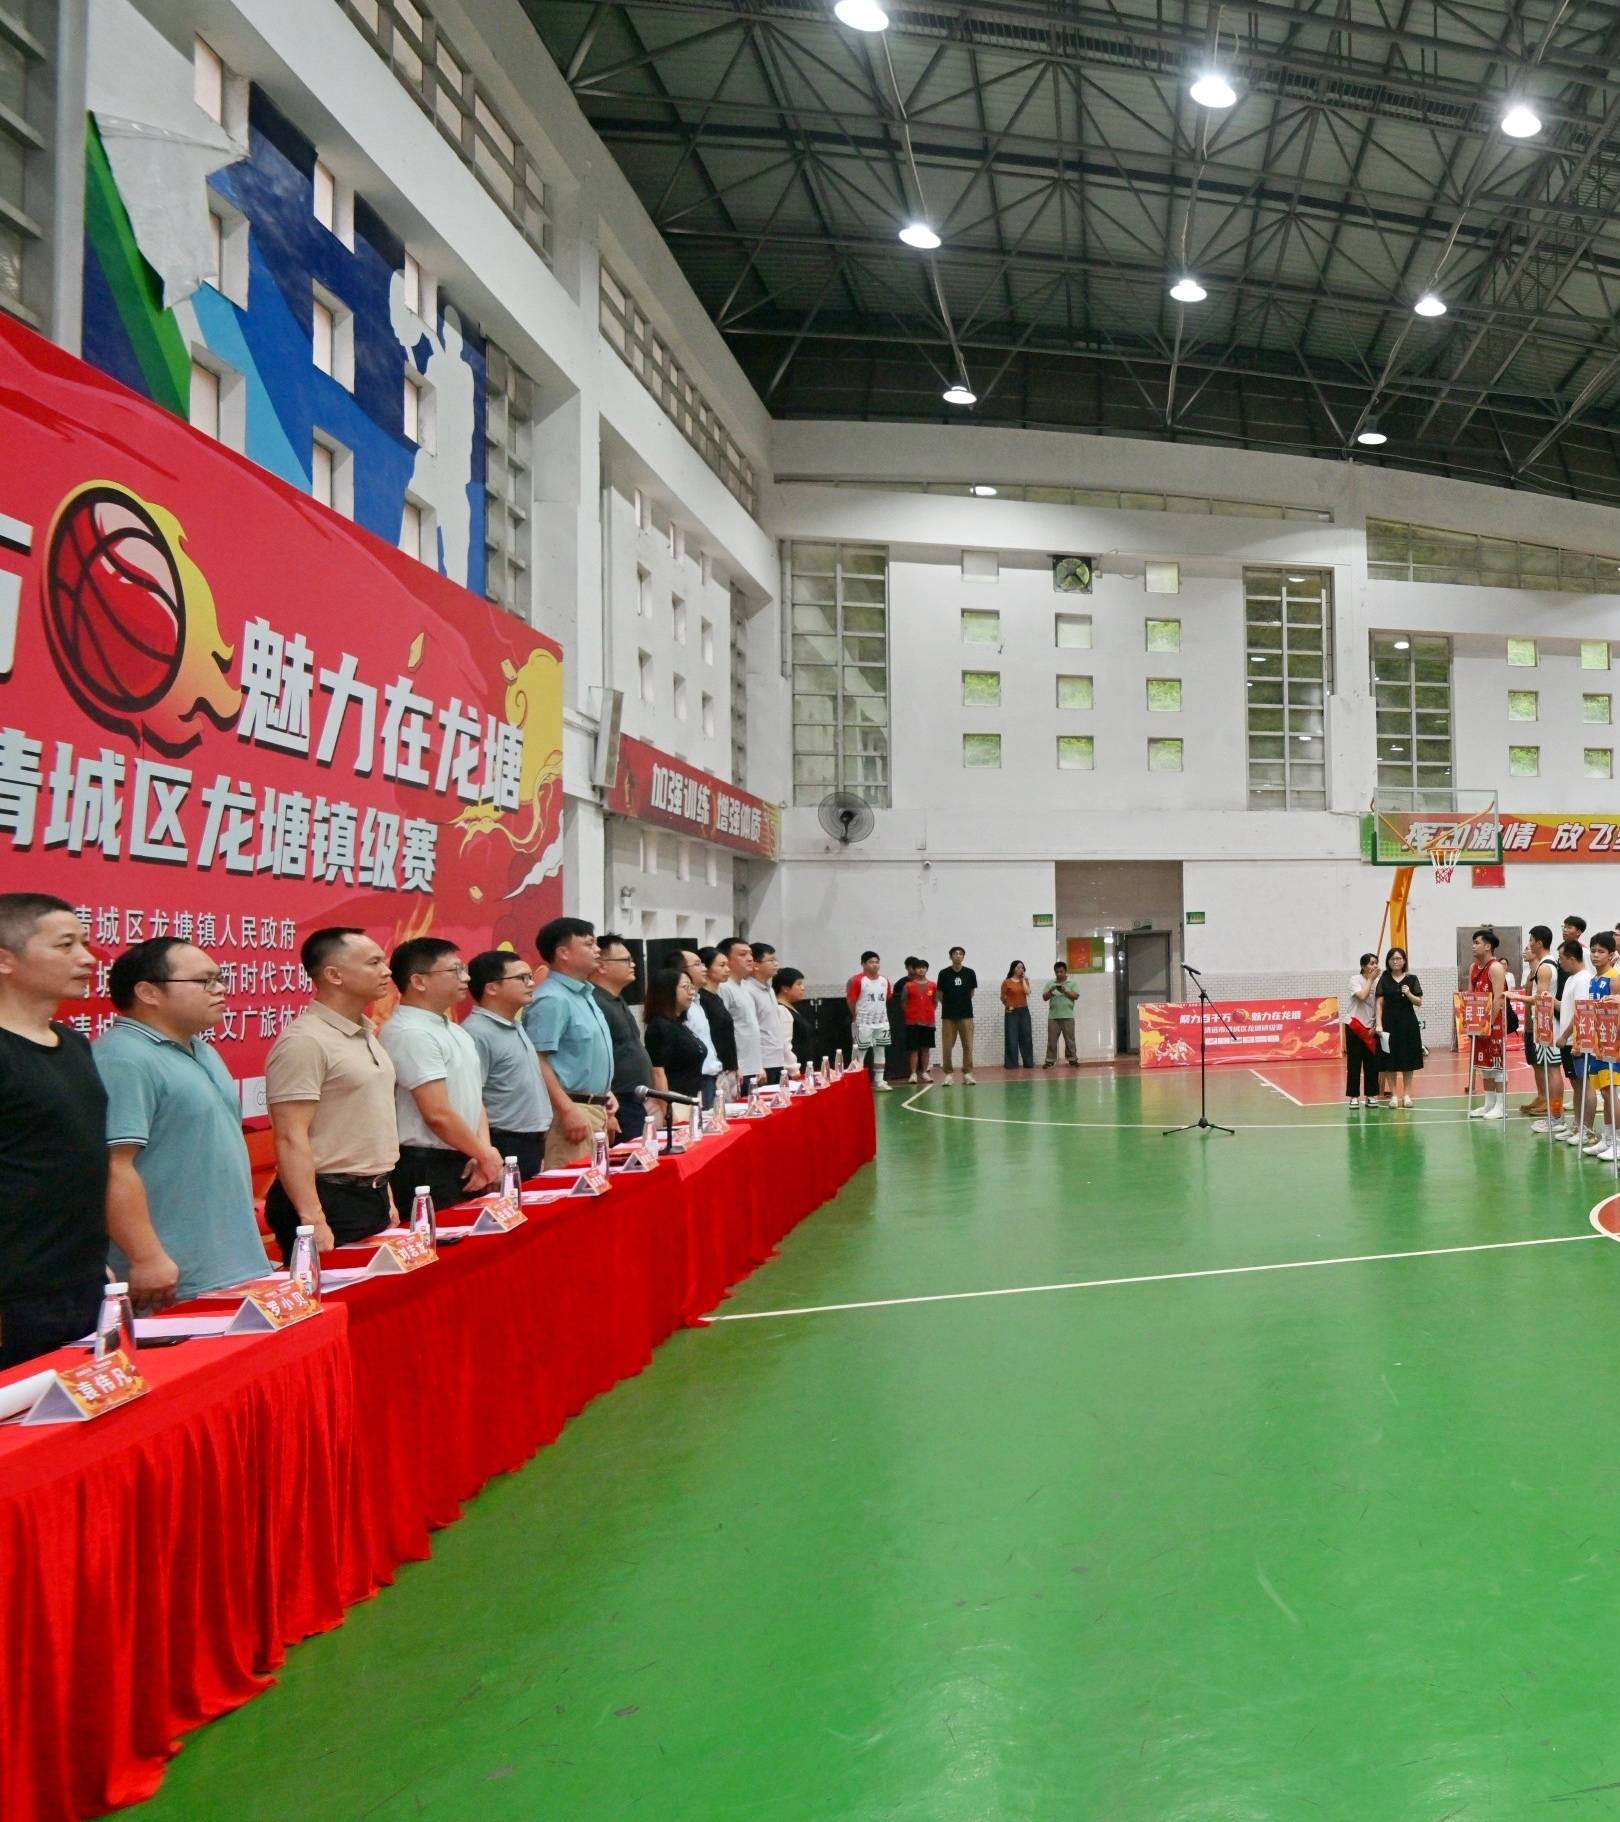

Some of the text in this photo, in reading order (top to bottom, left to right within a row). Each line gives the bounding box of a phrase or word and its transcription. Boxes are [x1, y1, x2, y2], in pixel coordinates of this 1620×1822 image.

[236, 615, 524, 810] 魅力在龙塘
[651, 762, 761, 843] 加强训练 增强体质
